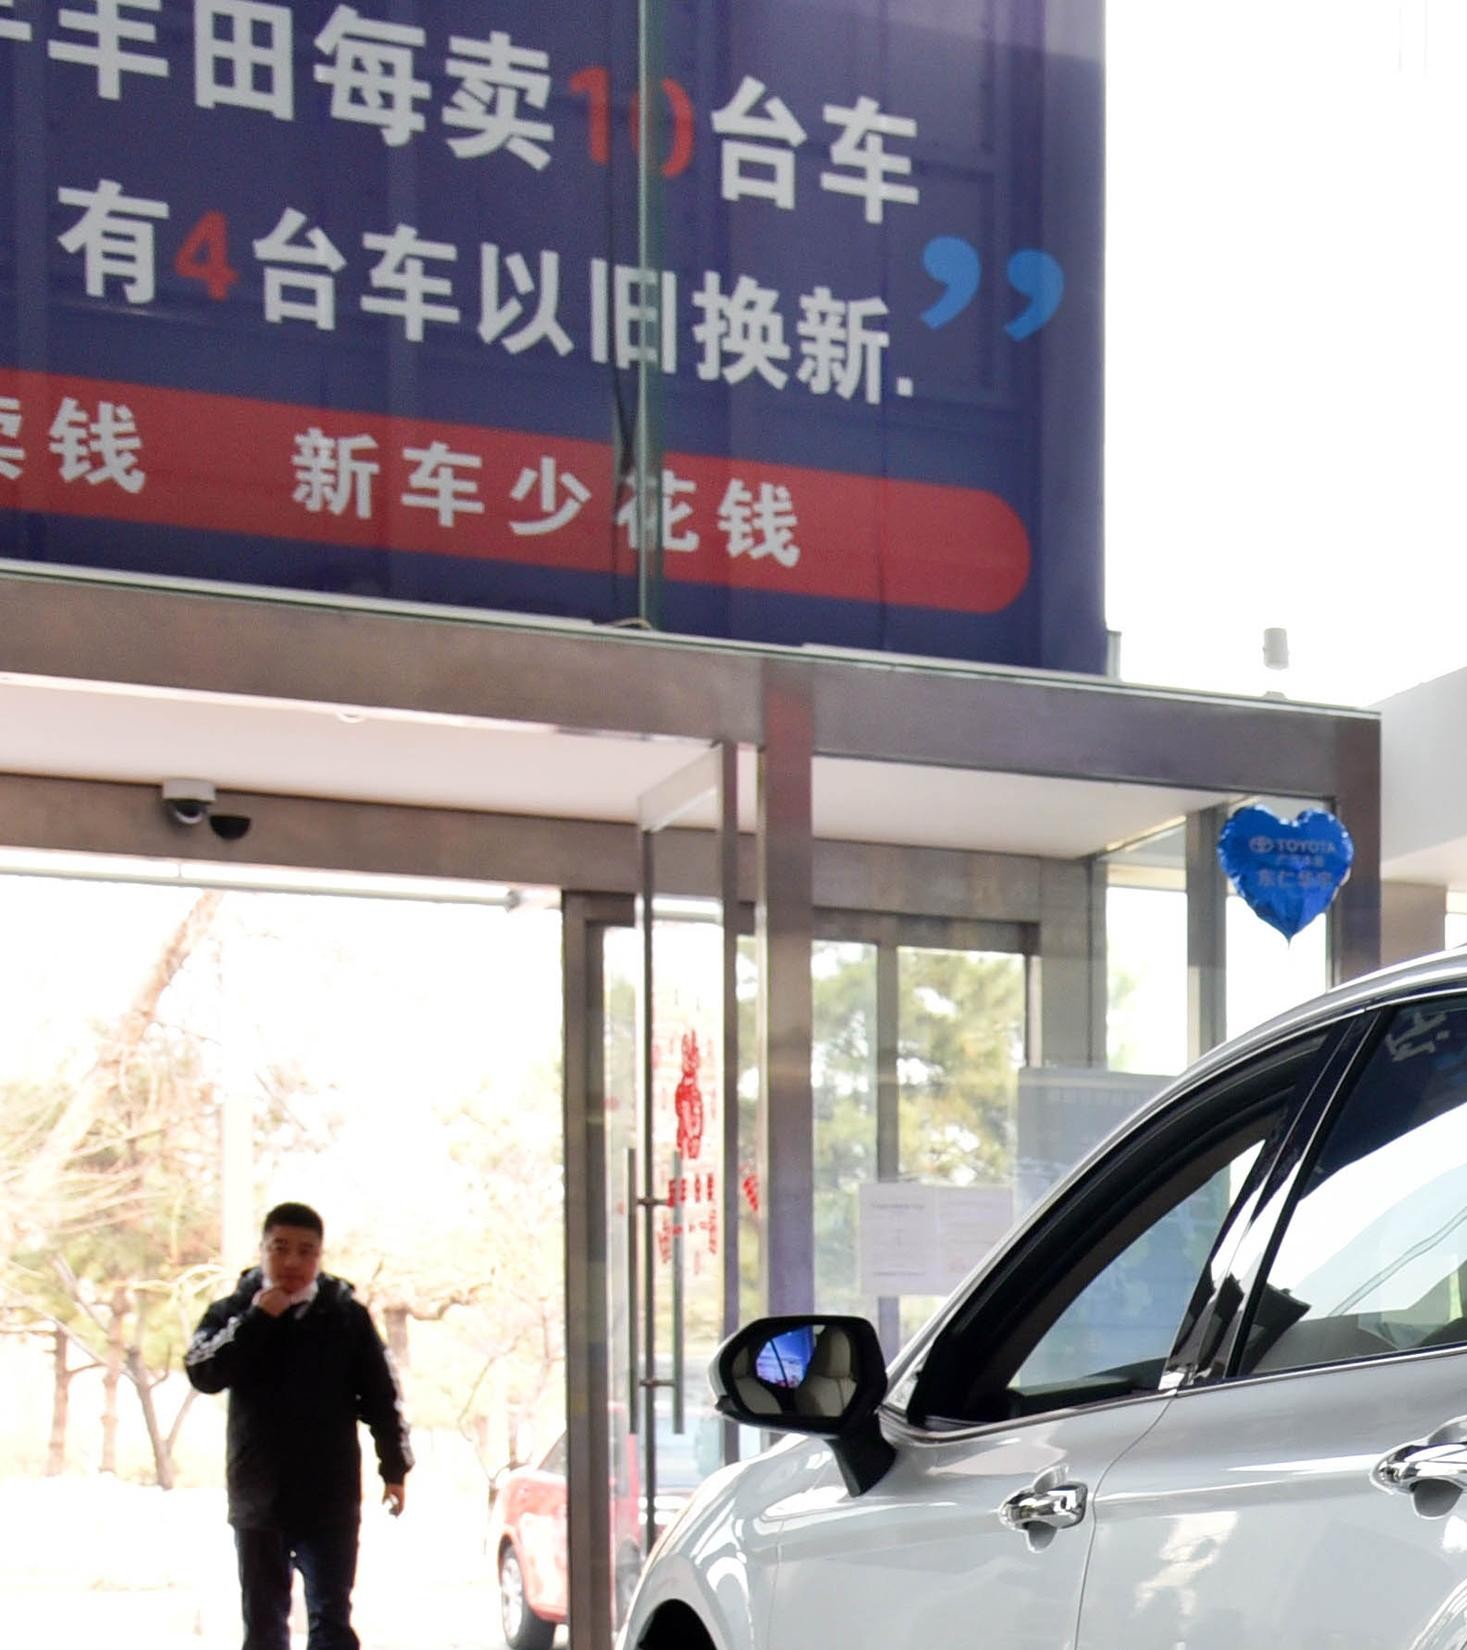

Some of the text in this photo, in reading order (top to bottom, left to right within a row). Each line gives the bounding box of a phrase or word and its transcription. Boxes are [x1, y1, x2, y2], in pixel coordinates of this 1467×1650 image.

[0, 0, 919, 223] 丰田每卖10台车
[293, 427, 800, 567] 新车少花钱
